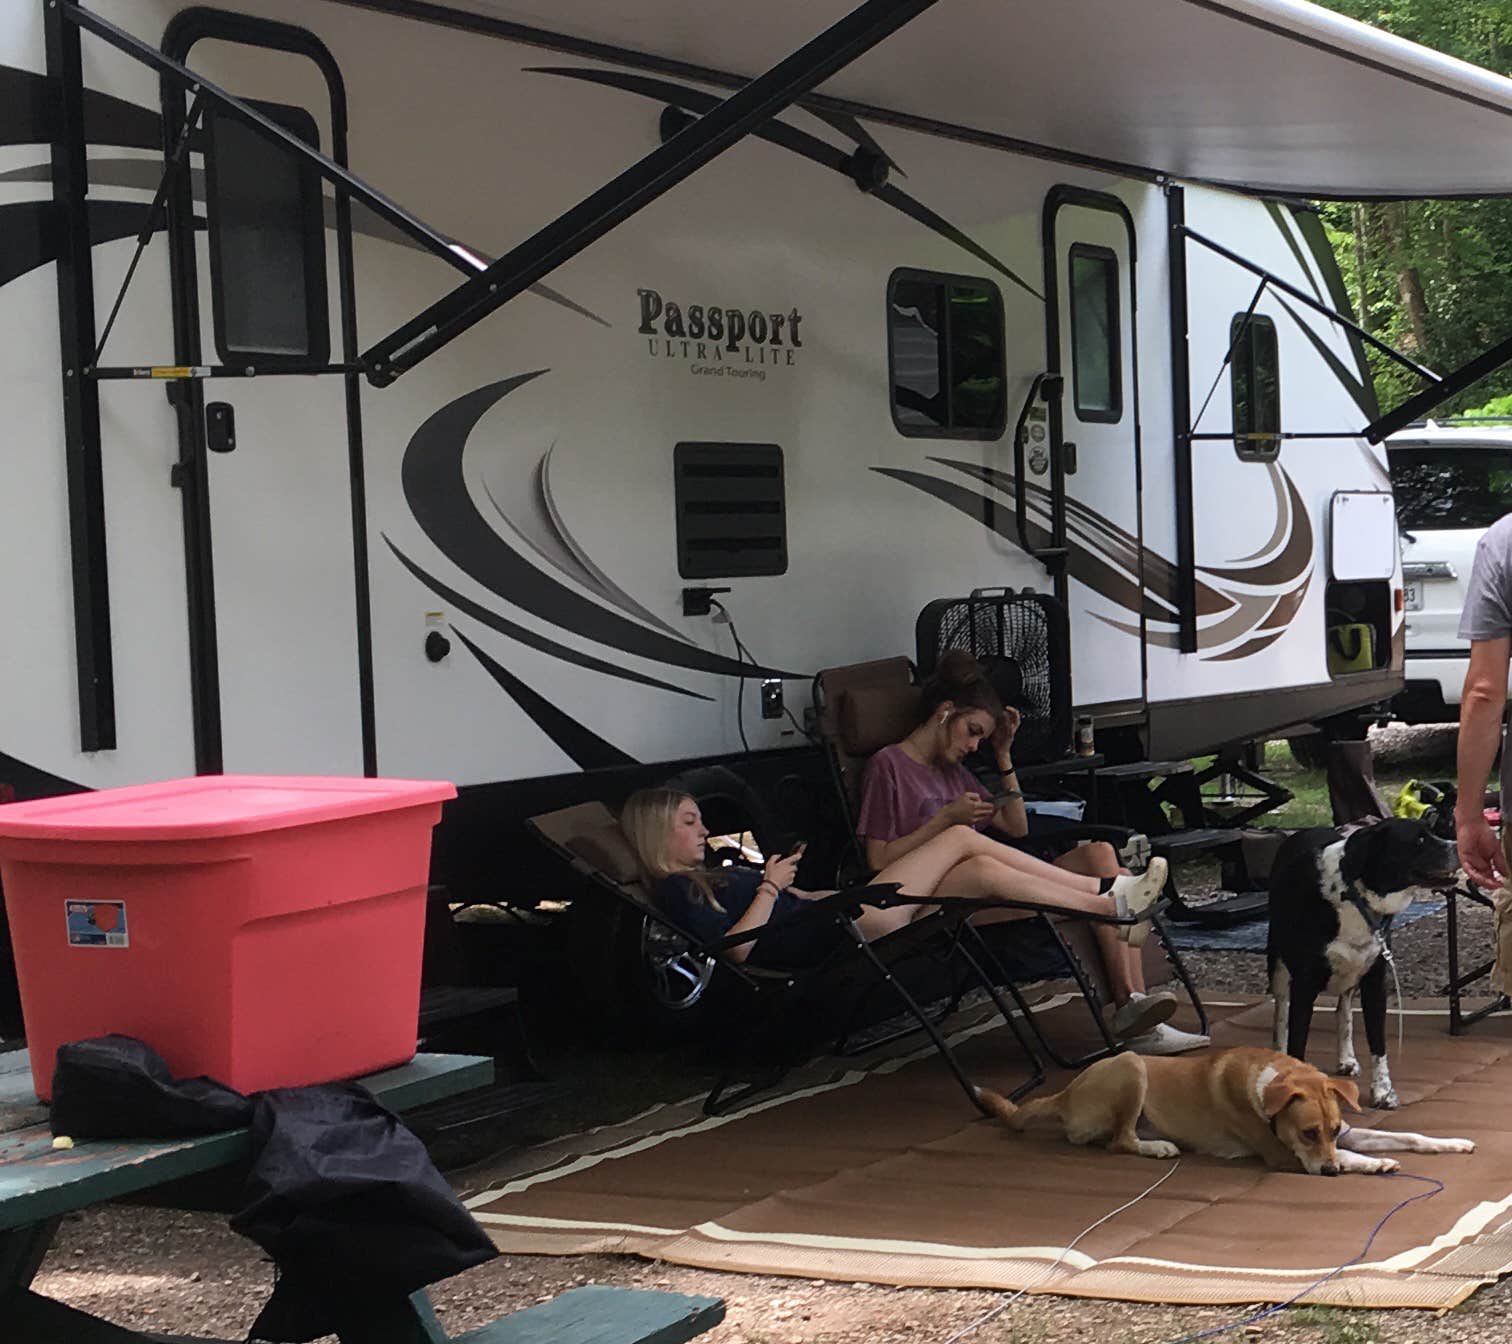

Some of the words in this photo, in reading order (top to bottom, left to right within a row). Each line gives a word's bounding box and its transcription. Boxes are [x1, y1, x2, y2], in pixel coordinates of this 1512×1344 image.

[637, 288, 802, 353] Passport
[649, 339, 722, 361] ULTRA
[745, 346, 795, 365] LITE
[690, 364, 724, 377] Grand
[726, 366, 766, 382] Touring
